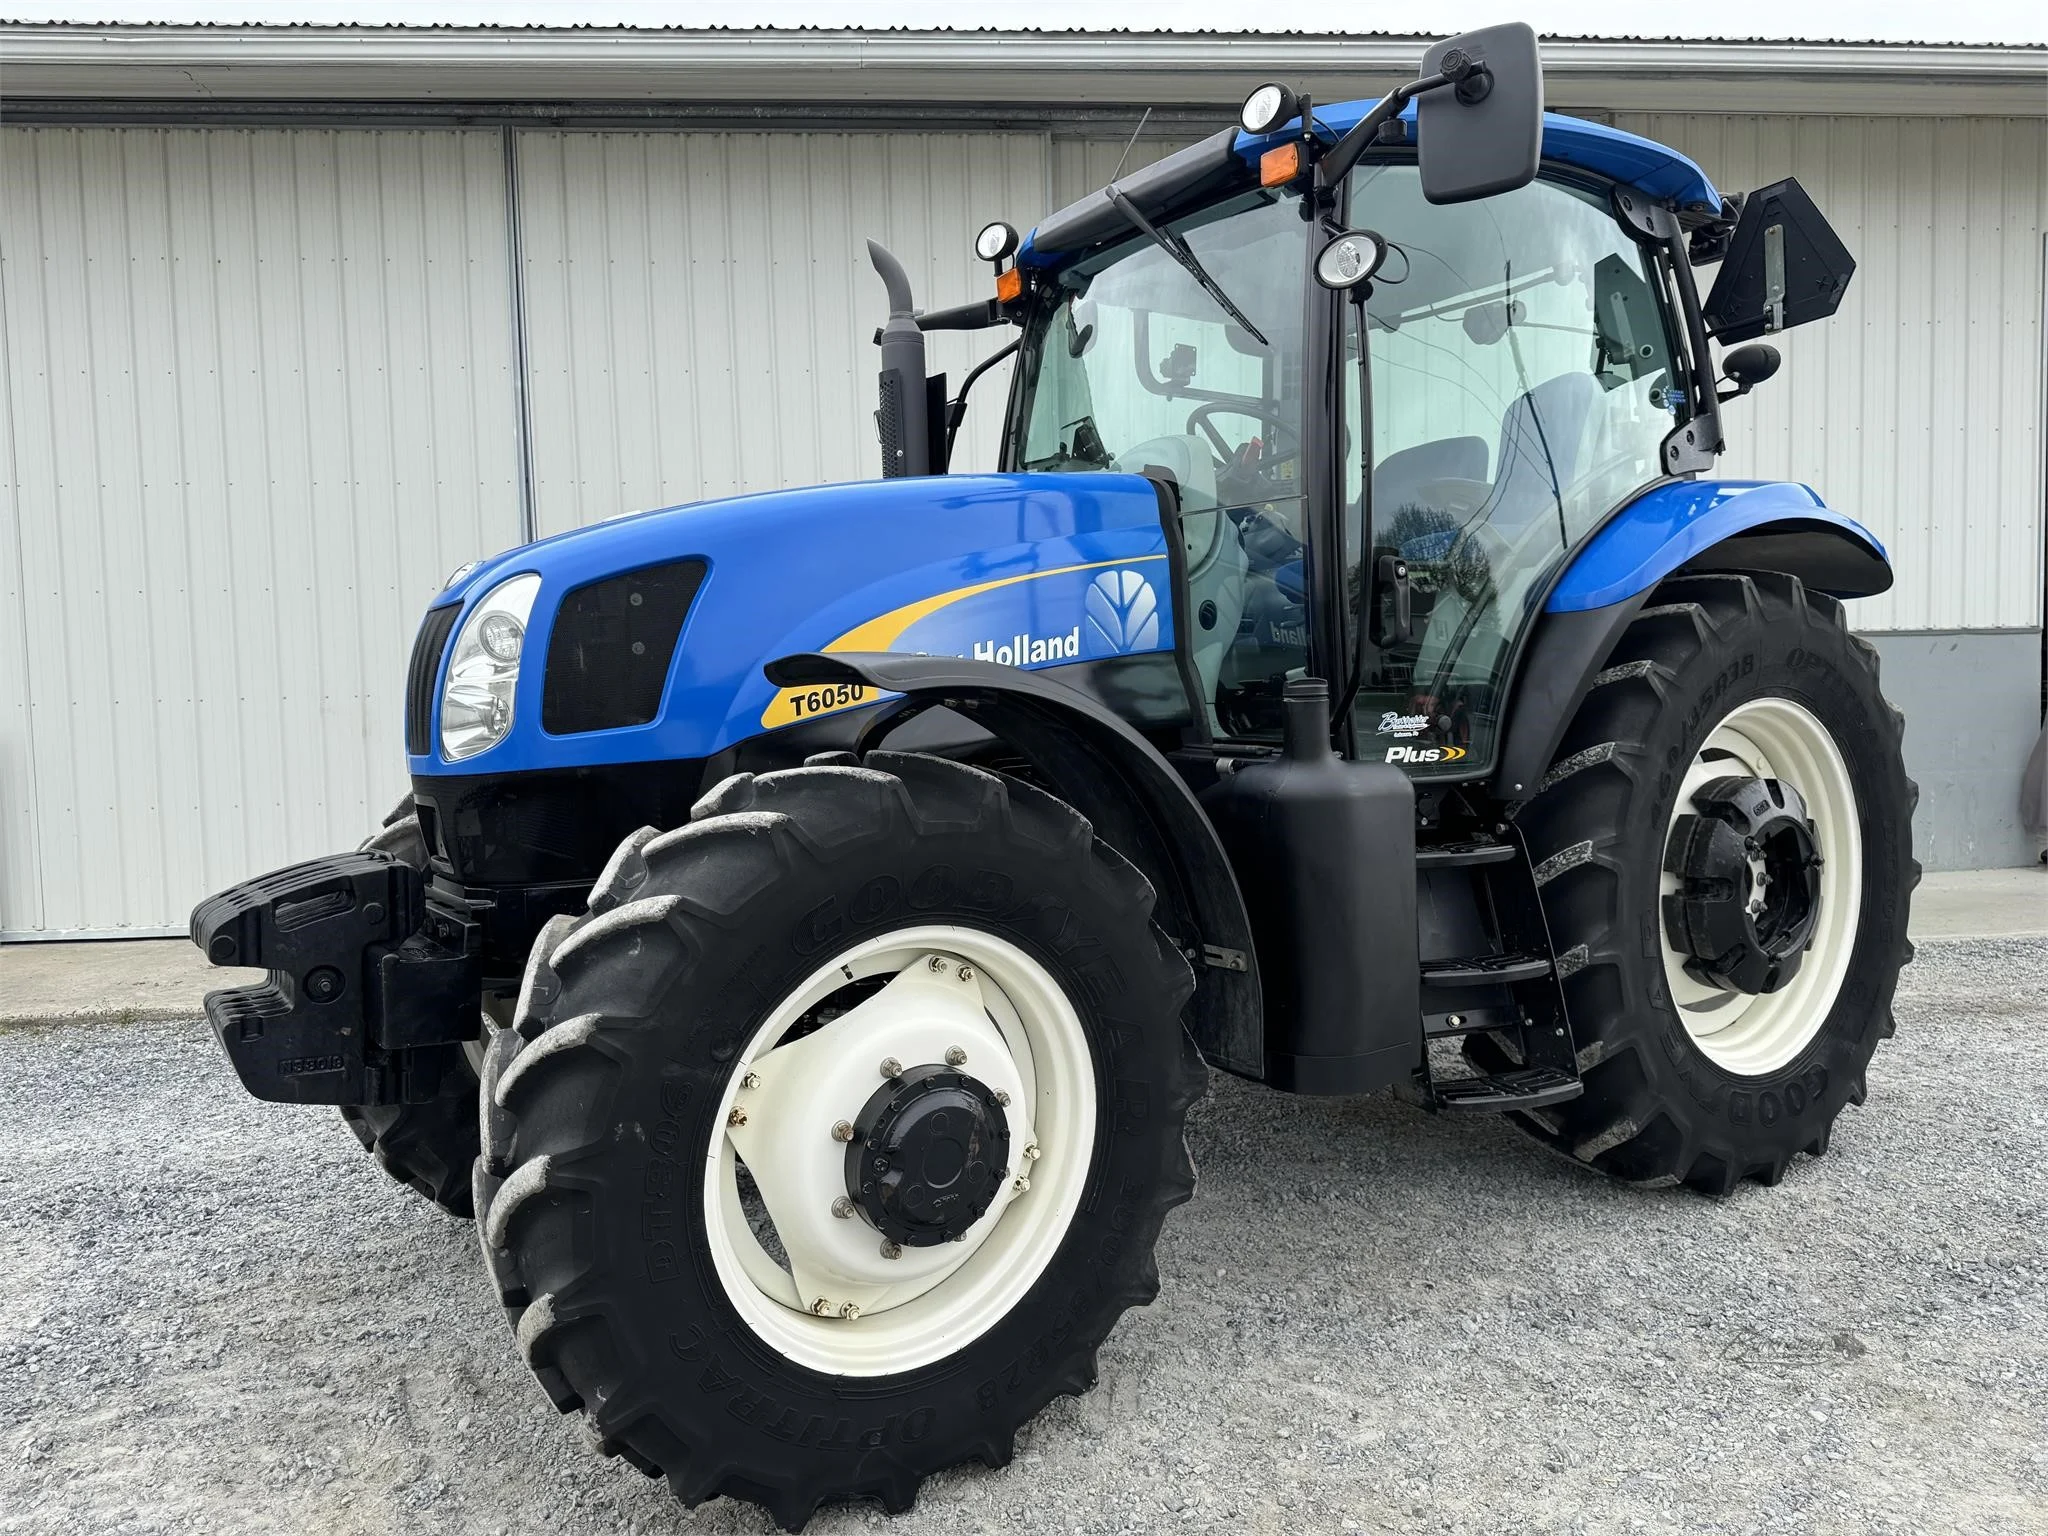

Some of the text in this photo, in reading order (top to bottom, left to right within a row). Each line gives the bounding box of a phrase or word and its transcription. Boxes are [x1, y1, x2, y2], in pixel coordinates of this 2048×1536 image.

[974, 626, 1079, 667] Holland
[790, 683, 864, 717] T6050
[1385, 746, 1441, 764] Plus
[790, 863, 1153, 1138] GOODYEAR
